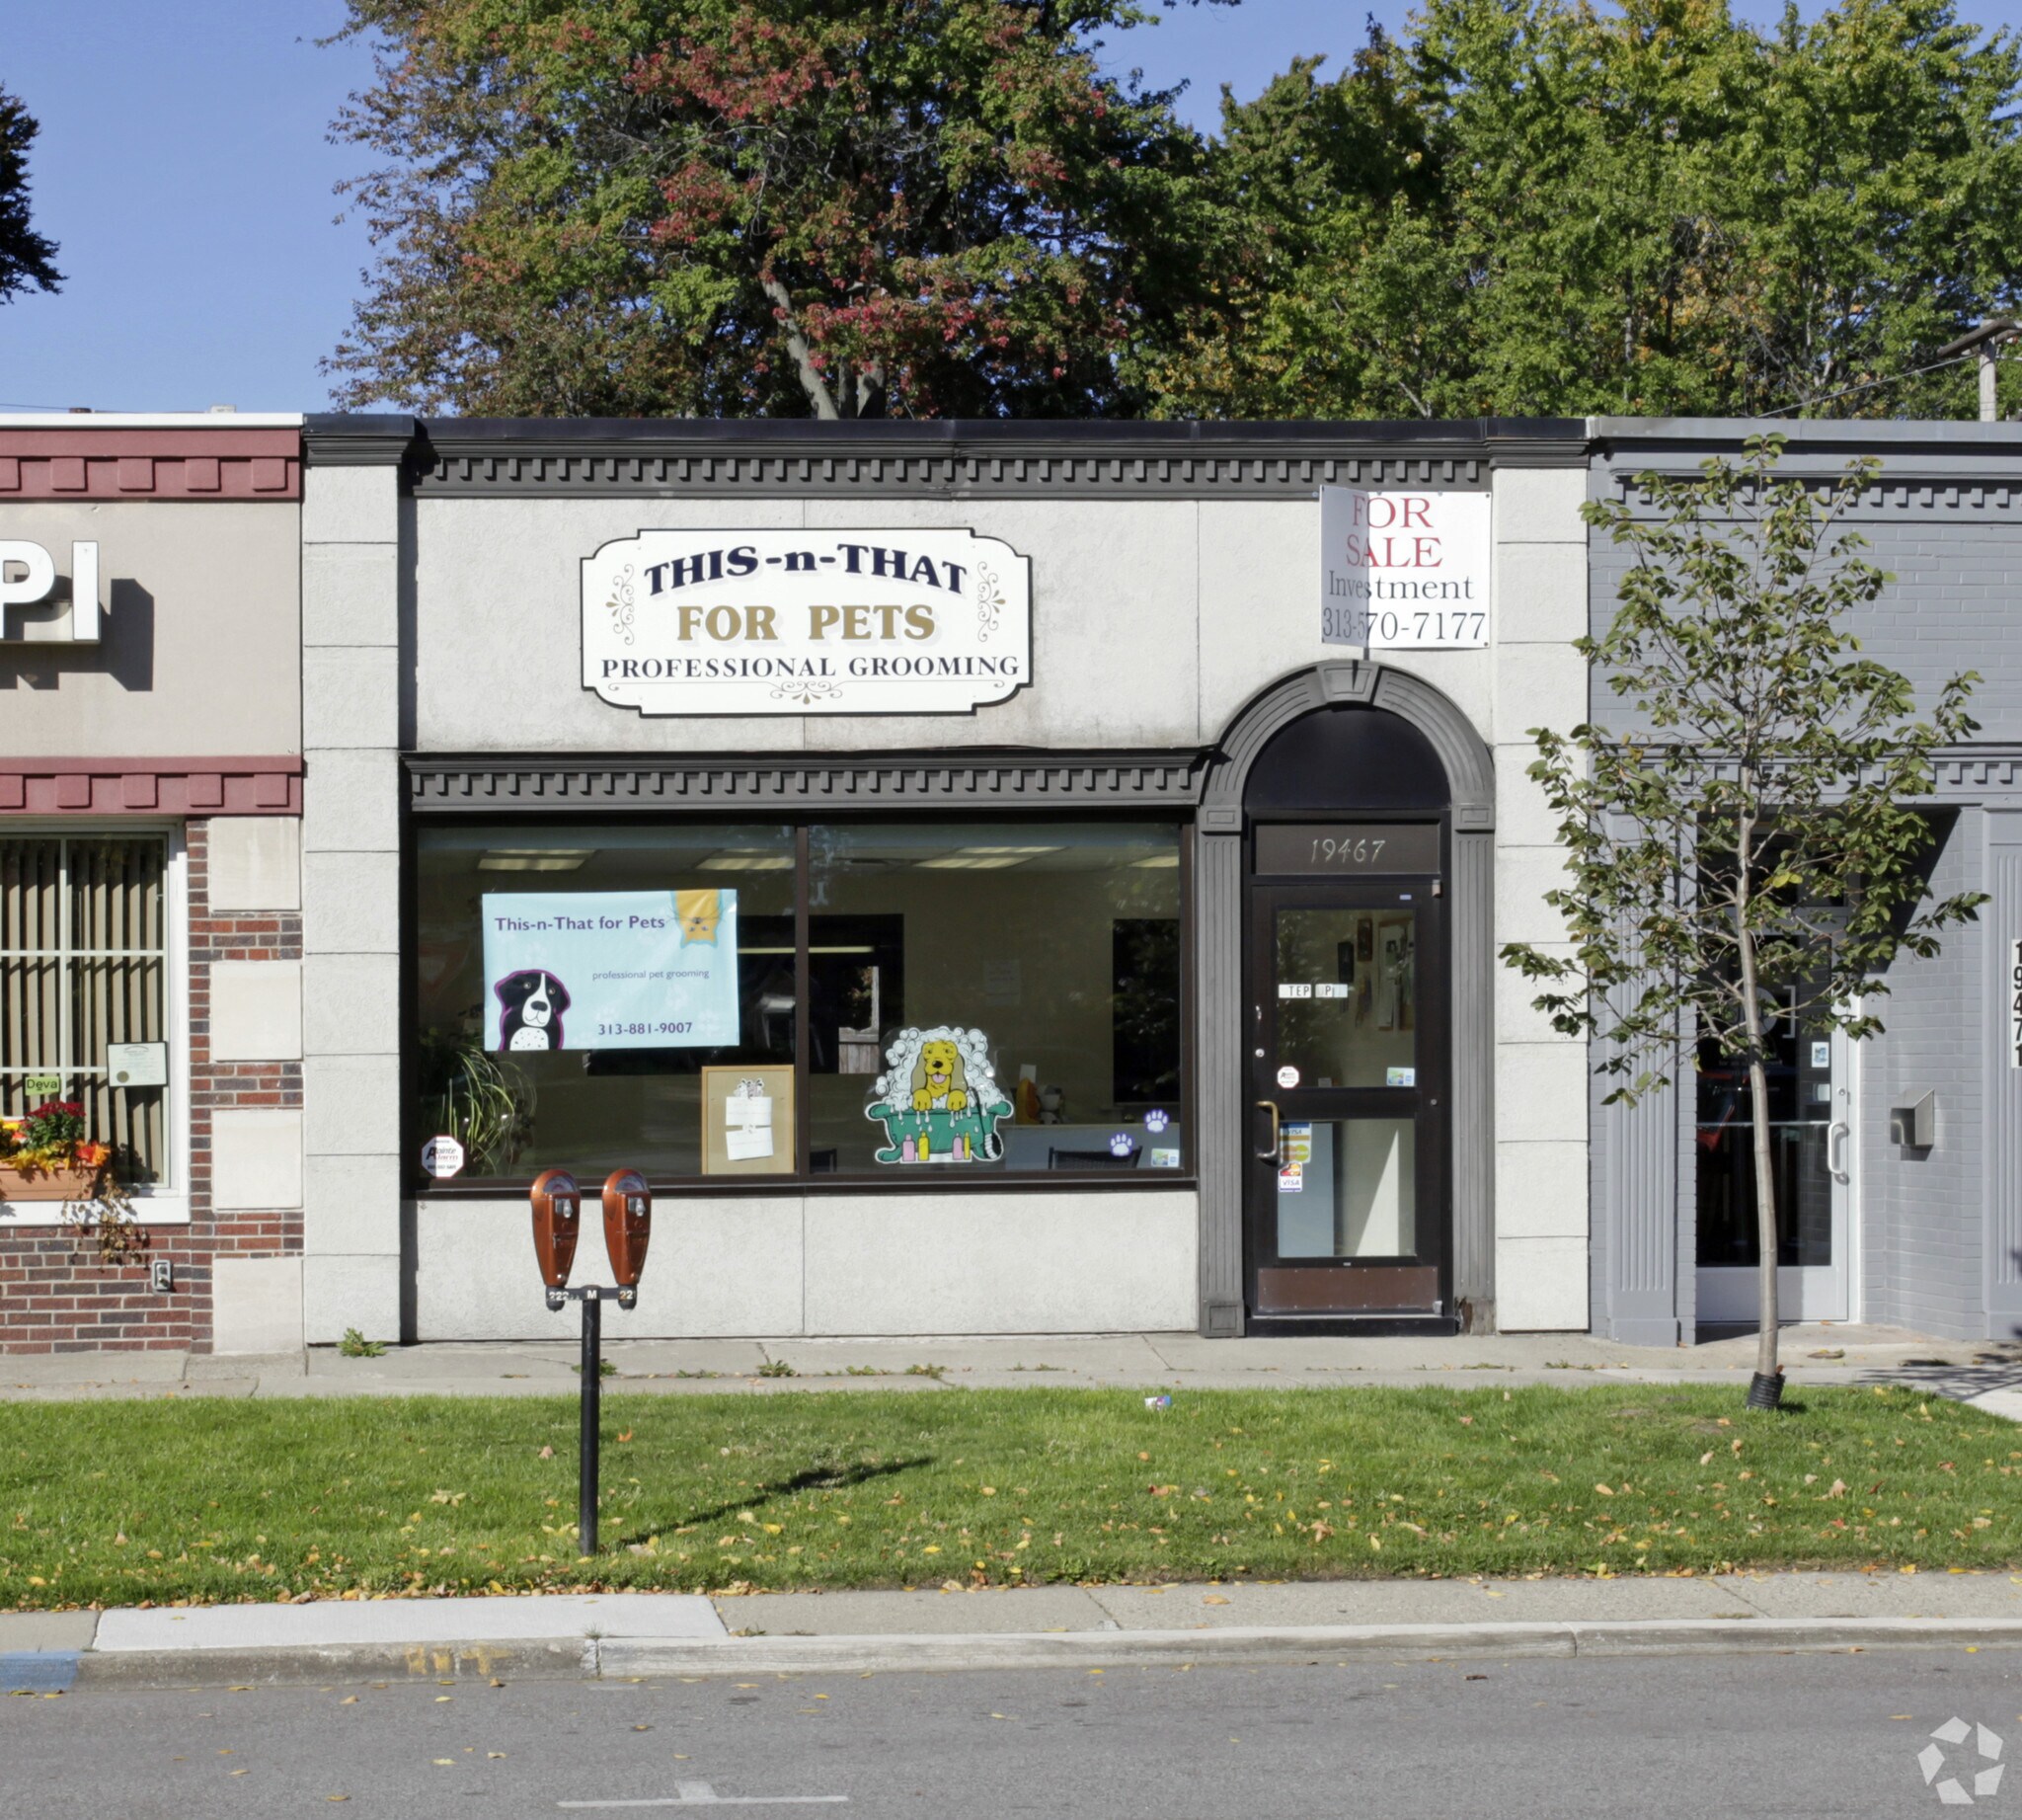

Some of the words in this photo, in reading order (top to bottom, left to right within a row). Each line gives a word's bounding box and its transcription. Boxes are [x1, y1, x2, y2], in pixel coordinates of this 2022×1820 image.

[1352, 495, 1434, 528] FOR
[1346, 534, 1442, 568] SALE
[643, 543, 968, 596] THIS-n-THAT
[1329, 570, 1475, 599] Investment
[676, 605, 778, 641] FOR
[808, 604, 936, 641] PETS
[1323, 607, 1486, 641] 313-570-7177
[601, 658, 836, 678] PROFESSIONAL
[848, 656, 1020, 676] GROOMING
[1311, 838, 1385, 863] 19467
[495, 916, 593, 931] This-n-That
[598, 915, 623, 929] for
[628, 914, 665, 929] Pets
[592, 971, 647, 981] professional
[649, 972, 664, 981] pet
[666, 970, 710, 981] grooming
[598, 1022, 693, 1035] 313-881-9007
[27, 1078, 58, 1090] Deva
